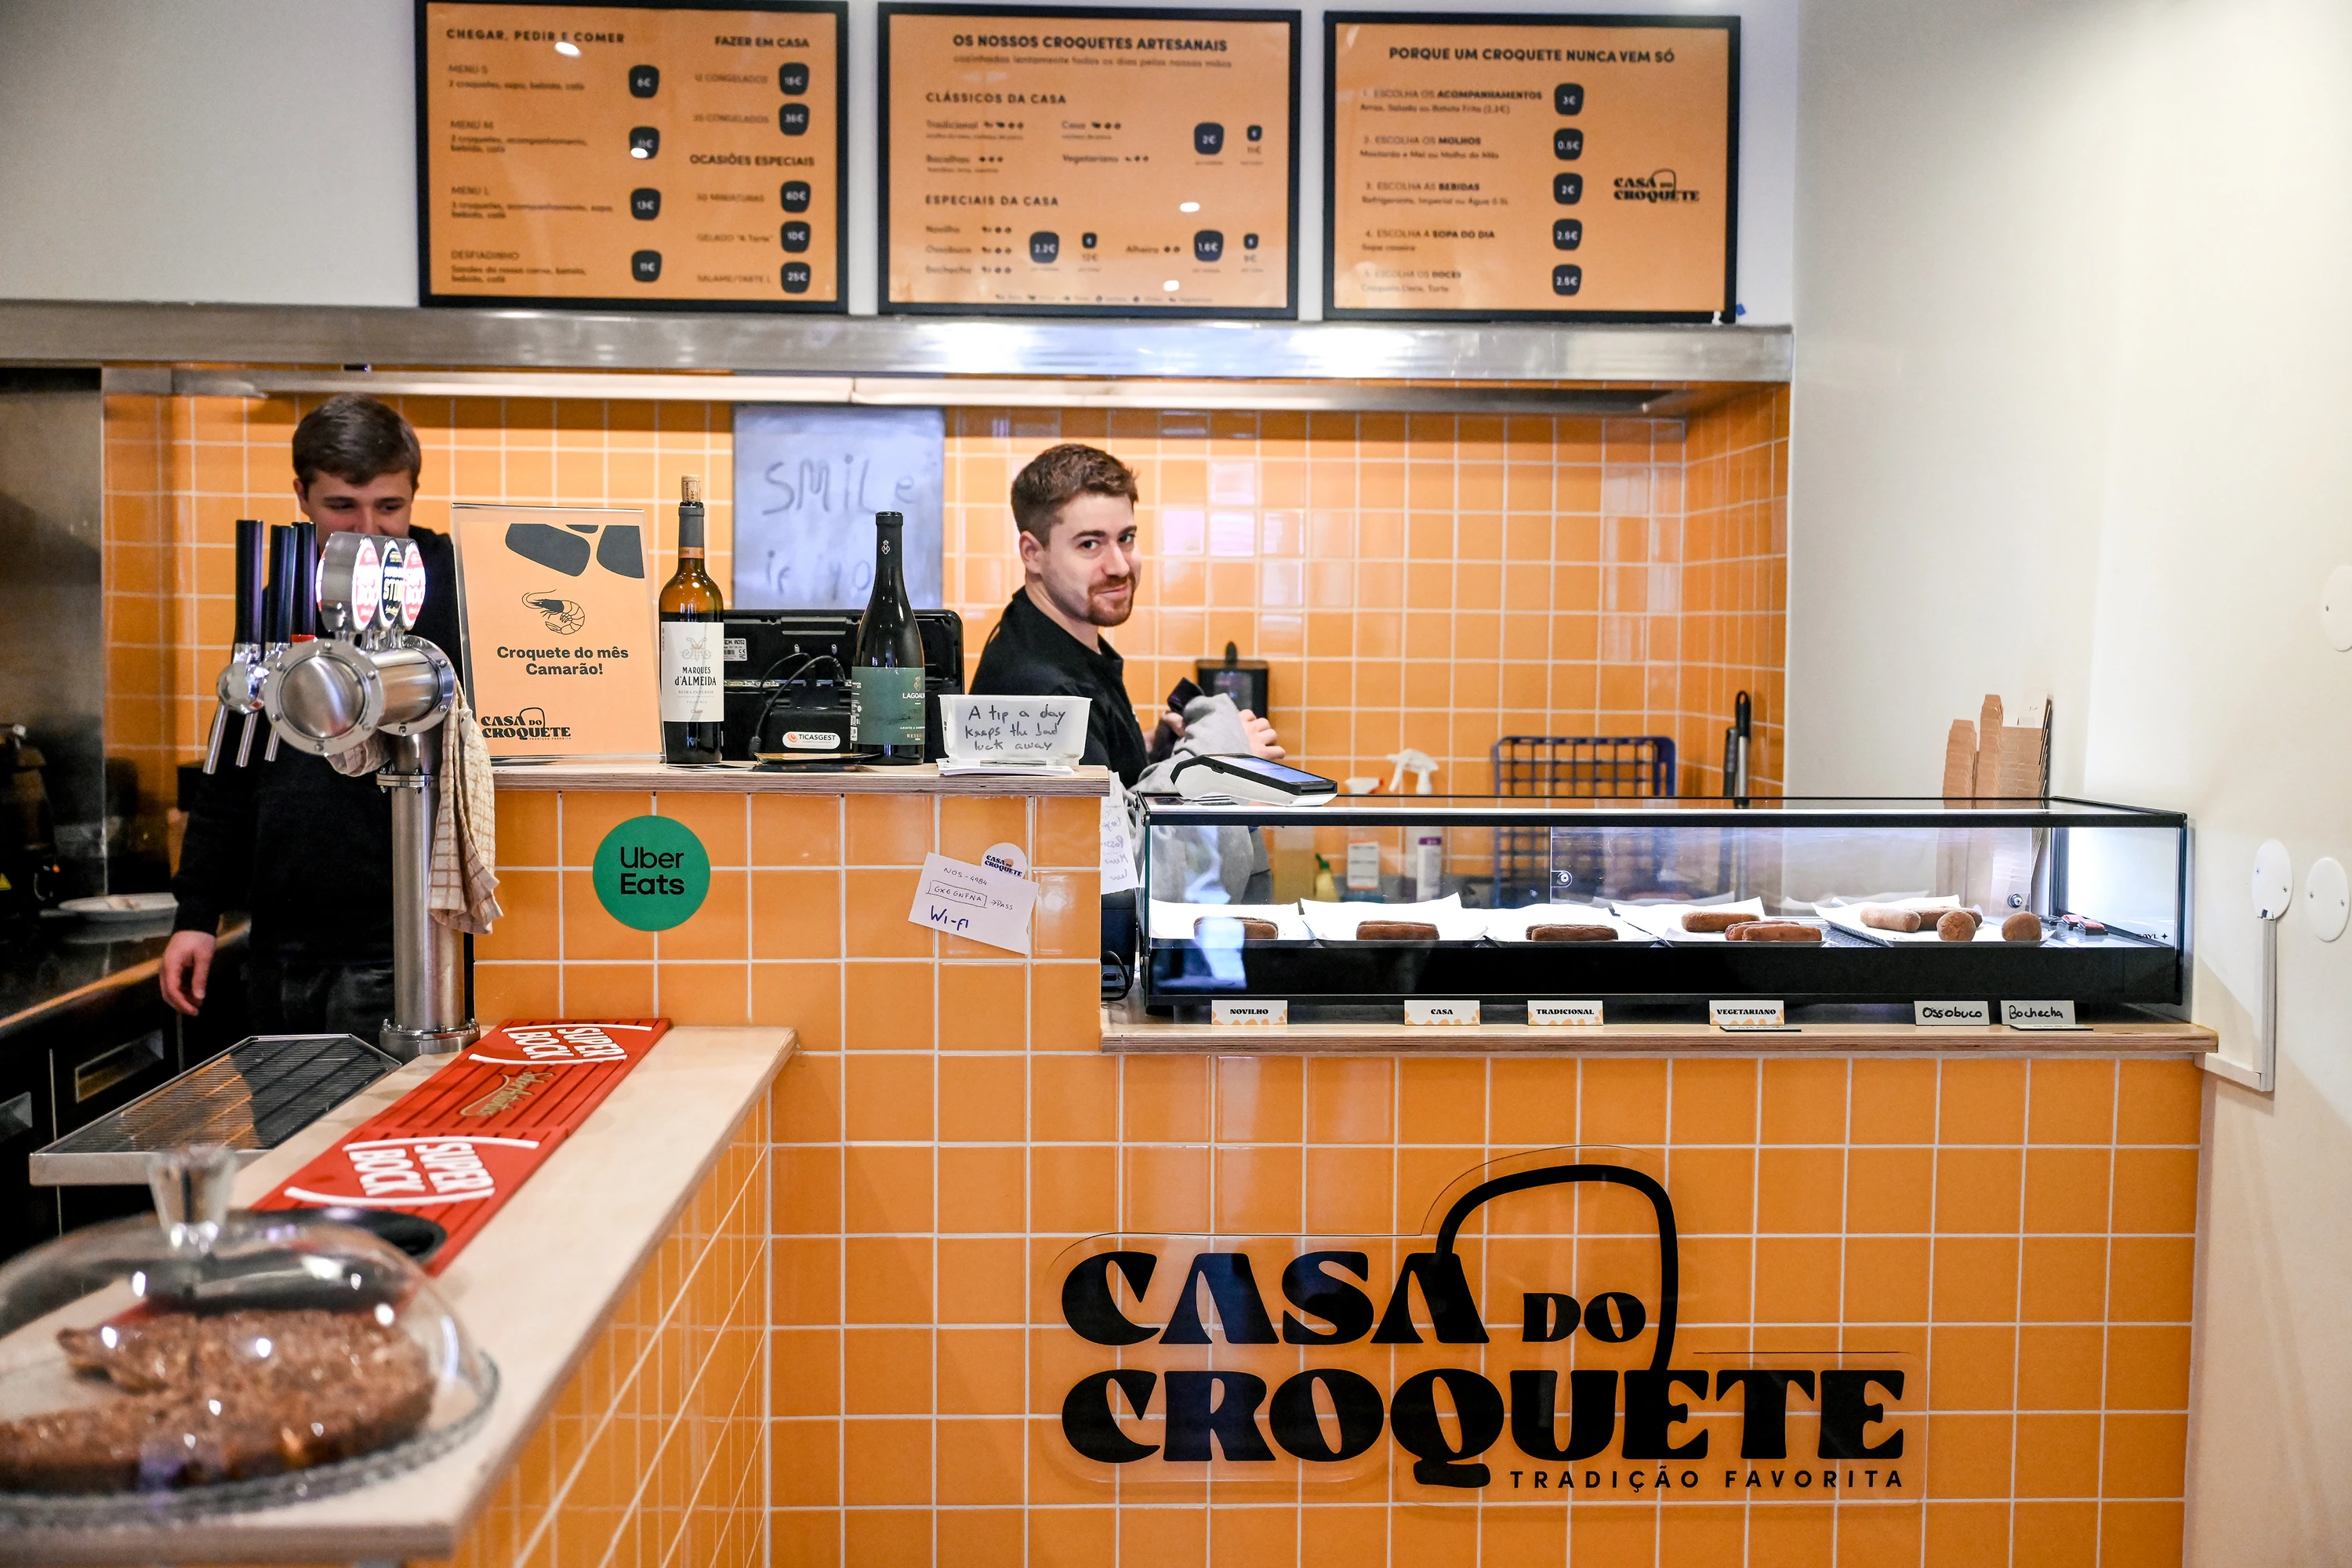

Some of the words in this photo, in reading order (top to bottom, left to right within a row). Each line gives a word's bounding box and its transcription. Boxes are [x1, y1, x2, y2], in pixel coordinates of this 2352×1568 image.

[514, 31, 555, 42] PEDIR
[575, 32, 624, 43] COMER
[714, 36, 752, 47] FAZER
[755, 37, 774, 47] EM
[777, 38, 810, 48] CASA
[953, 34, 974, 47] OS
[977, 34, 1039, 48] NOSSOS
[1043, 35, 1133, 50] CROQUETES
[1136, 38, 1229, 52] ARTESANAIS
[1389, 46, 1450, 60] PORQUE
[1454, 48, 1478, 60] UM
[1483, 49, 1563, 62] CROQUETE
[1566, 49, 1617, 63] NUNCA
[1620, 50, 1651, 64] VEM
[1654, 47, 1675, 64] SÓ
[926, 90, 1002, 104] CLÁSSICOS
[1007, 93, 1026, 104] DA
[1030, 93, 1067, 104] CASA
[1437, 90, 1542, 101] ACOMPANHAMENTOS
[1438, 136, 1481, 145] MOLHOS
[690, 152, 752, 167] OCASIÕES
[754, 155, 815, 167] ESPECIAIS
[1062, 154, 1119, 165] Vegetariano
[1438, 182, 1480, 192] BEBIDAS
[1613, 176, 1657, 189] CASA
[925, 194, 996, 207] ESPECIAIS
[1000, 195, 1019, 207] DA
[1023, 196, 1059, 207] CASA
[1613, 190, 1700, 204] CROQUETE
[1432, 230, 1458, 239] SOPA
[1460, 230, 1476, 239] DO
[1478, 230, 1494, 239] DIA
[496, 645, 571, 662] Croquete
[574, 646, 593, 659] do
[597, 645, 629, 659] mês
[525, 662, 604, 676] Camarão!
[480, 715, 526, 727] CASA
[968, 705, 981, 721] A
[989, 704, 1009, 723] tip
[1018, 710, 1030, 719] a
[1040, 704, 1066, 725] day
[481, 726, 572, 740] CROQUETE
[1010, 721, 1028, 737] the
[975, 739, 1004, 751] luck
[1014, 741, 1053, 751] away
[620, 846, 684, 869] Uber
[985, 855, 1005, 866] CASA
[984, 860, 1023, 877] CROQUETE
[620, 873, 685, 895] Eats
[996, 900, 1013, 910] PASS
[1922, 1005, 1983, 1018] Ossobuco
[2009, 1004, 2063, 1019] Bochecha
[507, 1031, 575, 1059] BOCK
[556, 1027, 626, 1058] SUPER
[348, 1148, 426, 1196] BOCK
[413, 1142, 495, 1193] SUPER
[1061, 1250, 1490, 1347] CASA
[1522, 1291, 1647, 1344] DO
[1061, 1367, 1907, 1490] CROQUETE
[1509, 1465, 1700, 1494] TRADIÇÃO
[1725, 1470, 1904, 1489] FAVORITA
